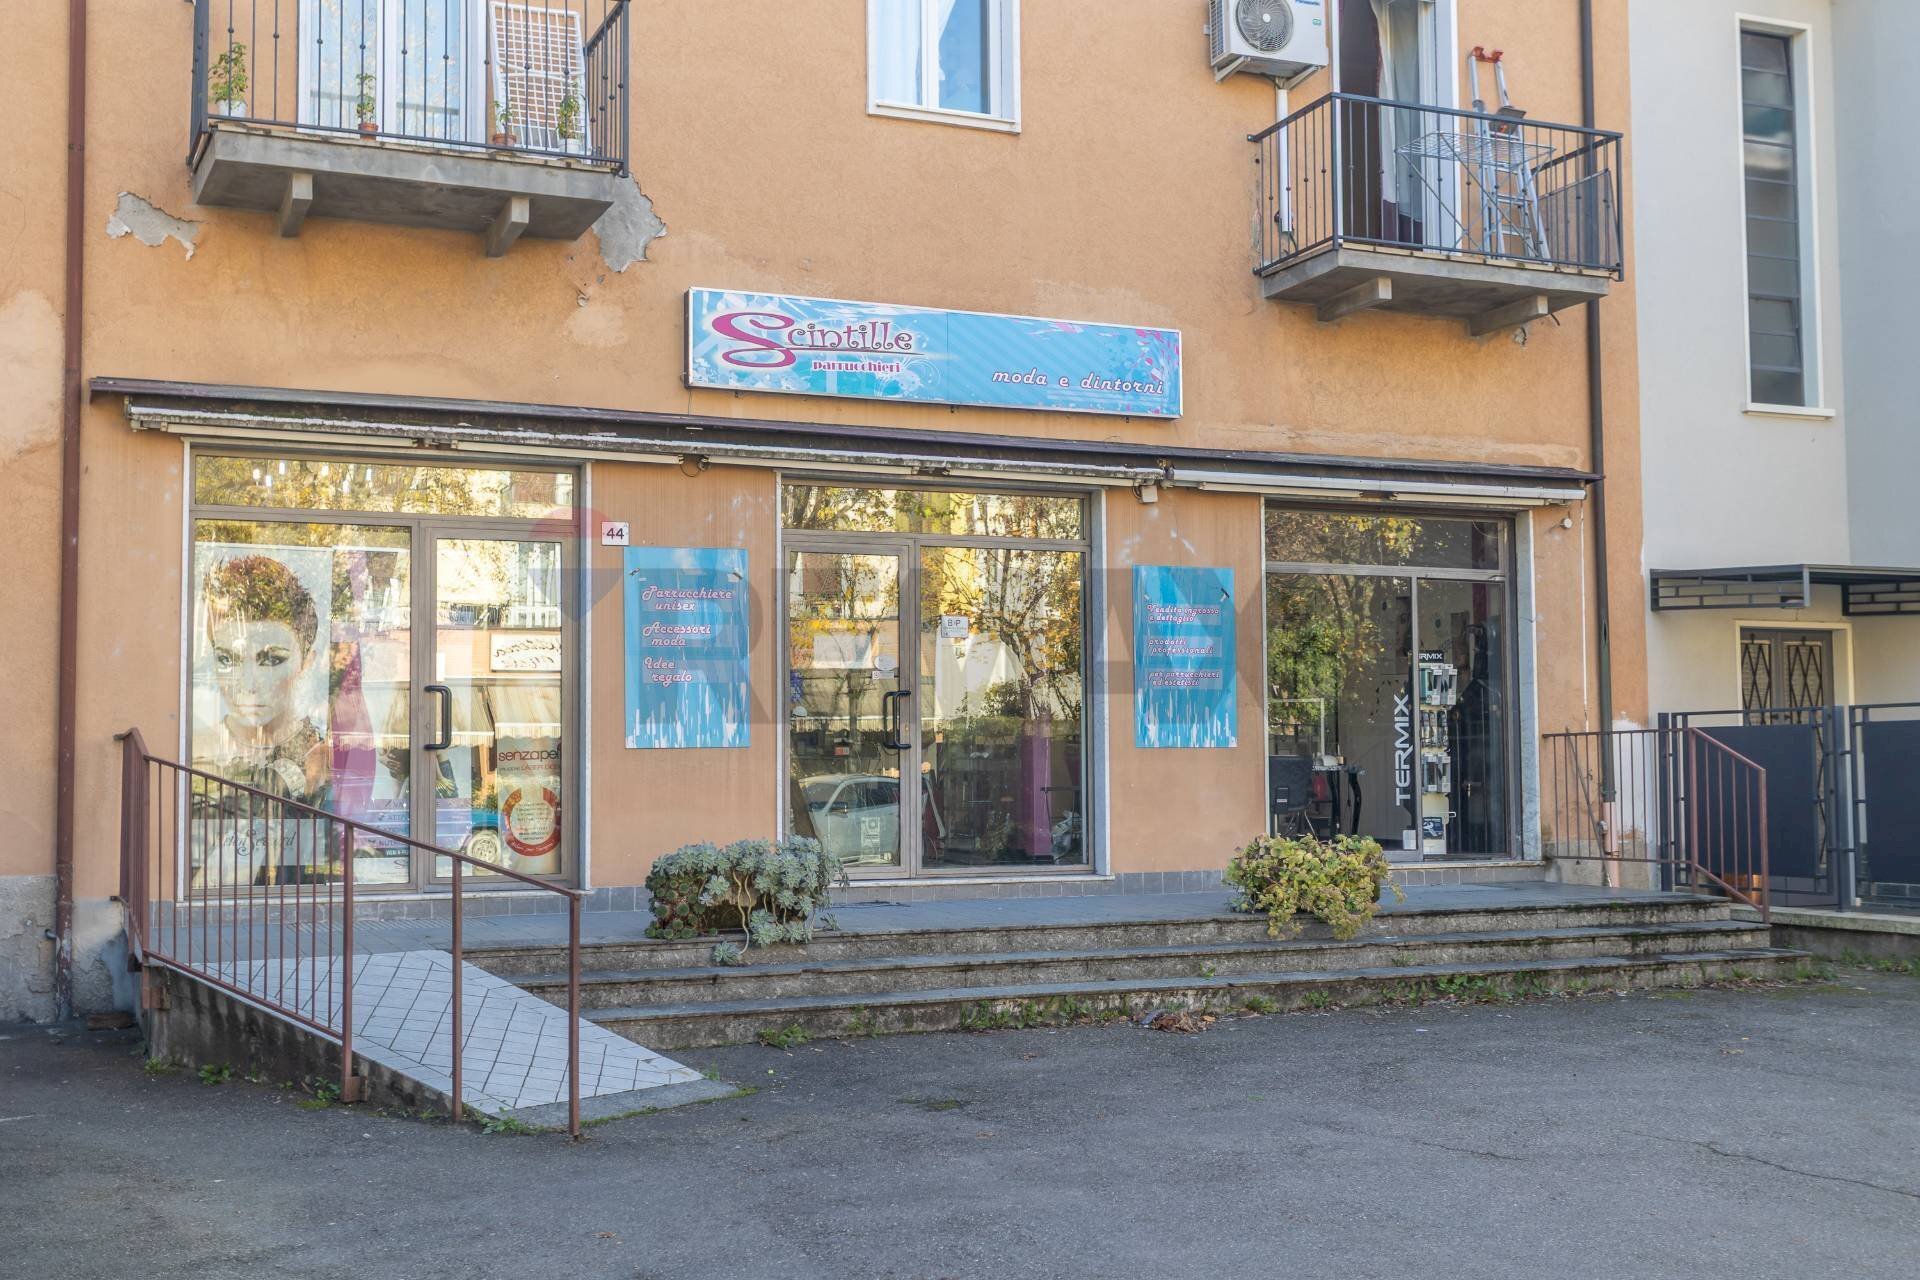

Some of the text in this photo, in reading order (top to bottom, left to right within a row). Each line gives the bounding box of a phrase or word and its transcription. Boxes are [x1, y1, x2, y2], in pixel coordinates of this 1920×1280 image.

[711, 312, 914, 368] Scintille
[812, 360, 901, 373] parrucchieri
[992, 368, 1164, 395] moda e dintorni
[606, 527, 625, 541] 44
[642, 585, 733, 601] Parrucchiere
[655, 601, 696, 611] unisex
[1147, 604, 1182, 614] Vendita
[643, 622, 711, 636] Accessori
[651, 635, 687, 647] moda
[644, 657, 676, 669] Idee
[1419, 653, 1444, 661] RMIX
[651, 670, 693, 687] regalo
[1394, 694, 1413, 806] TERMIX
